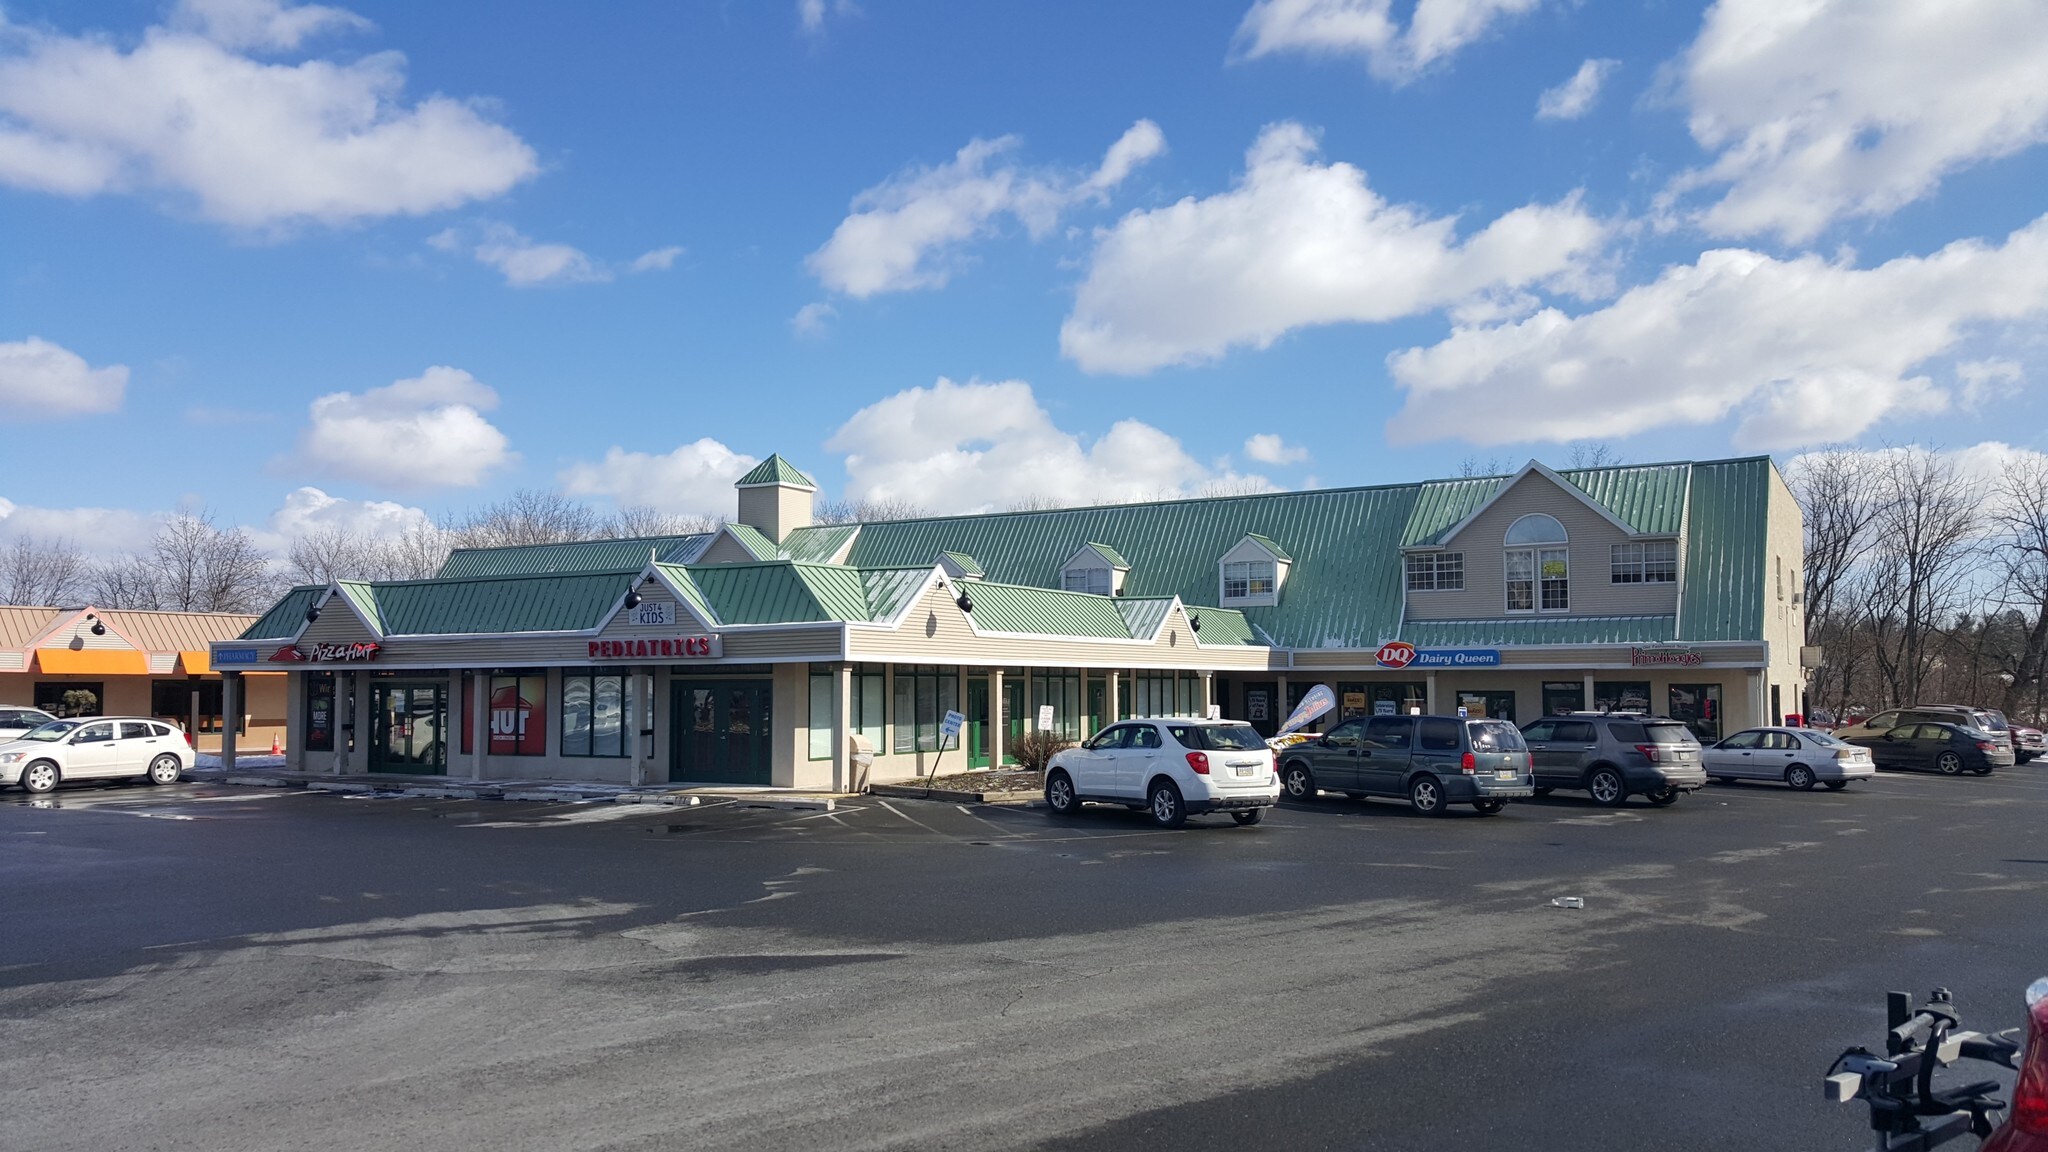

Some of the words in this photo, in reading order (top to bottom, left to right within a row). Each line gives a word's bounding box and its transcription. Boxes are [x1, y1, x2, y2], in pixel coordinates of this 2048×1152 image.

[640, 603, 657, 612] JUST
[657, 603, 662, 611] 4
[640, 612, 664, 624] KIDS
[588, 637, 710, 657] PEDIATRICS
[1382, 647, 1410, 663] DQ
[1419, 653, 1452, 666] Dairy
[1454, 652, 1496, 664] Queen
[1304, 697, 1329, 719] Julius
[312, 710, 328, 721] MORE
[948, 712, 962, 721] PHOTO
[944, 718, 961, 728] CENTER
